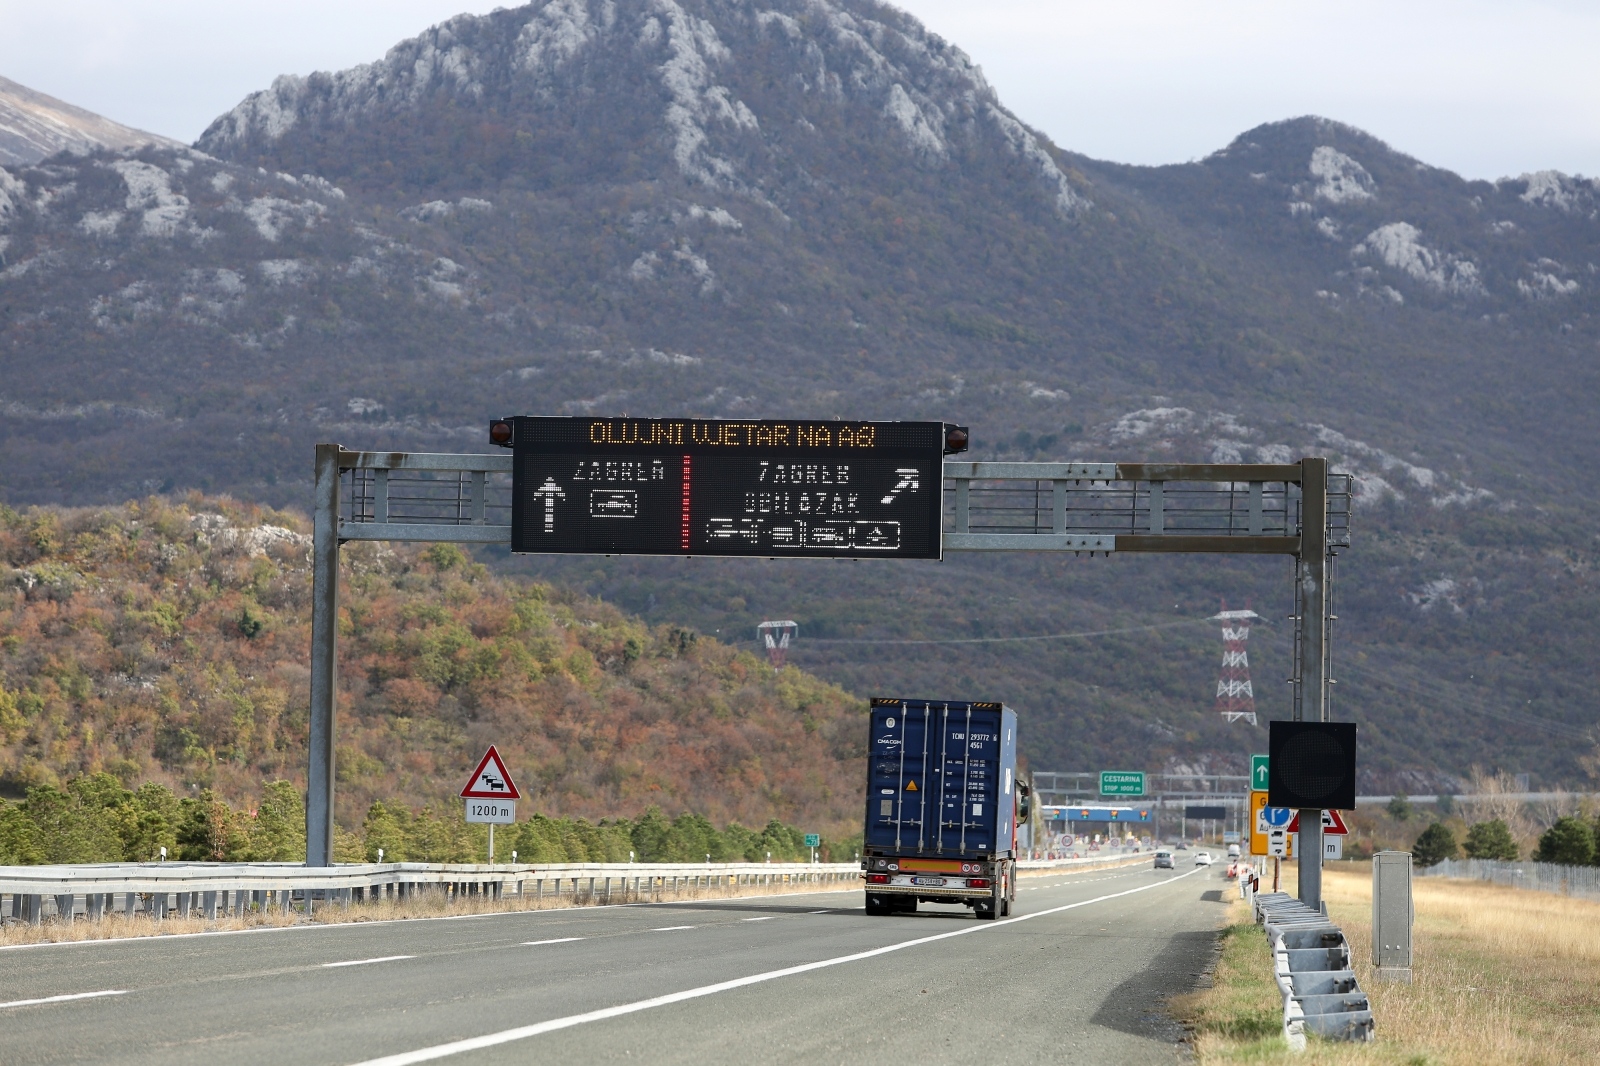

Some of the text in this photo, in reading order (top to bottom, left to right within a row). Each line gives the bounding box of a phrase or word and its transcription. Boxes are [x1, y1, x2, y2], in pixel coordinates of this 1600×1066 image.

[591, 422, 684, 444] OLUJNI
[692, 423, 790, 446] VJETAR
[797, 425, 831, 447] NA
[1103, 775, 1141, 783] CESTARINA
[472, 805, 509, 817] 1200 m
